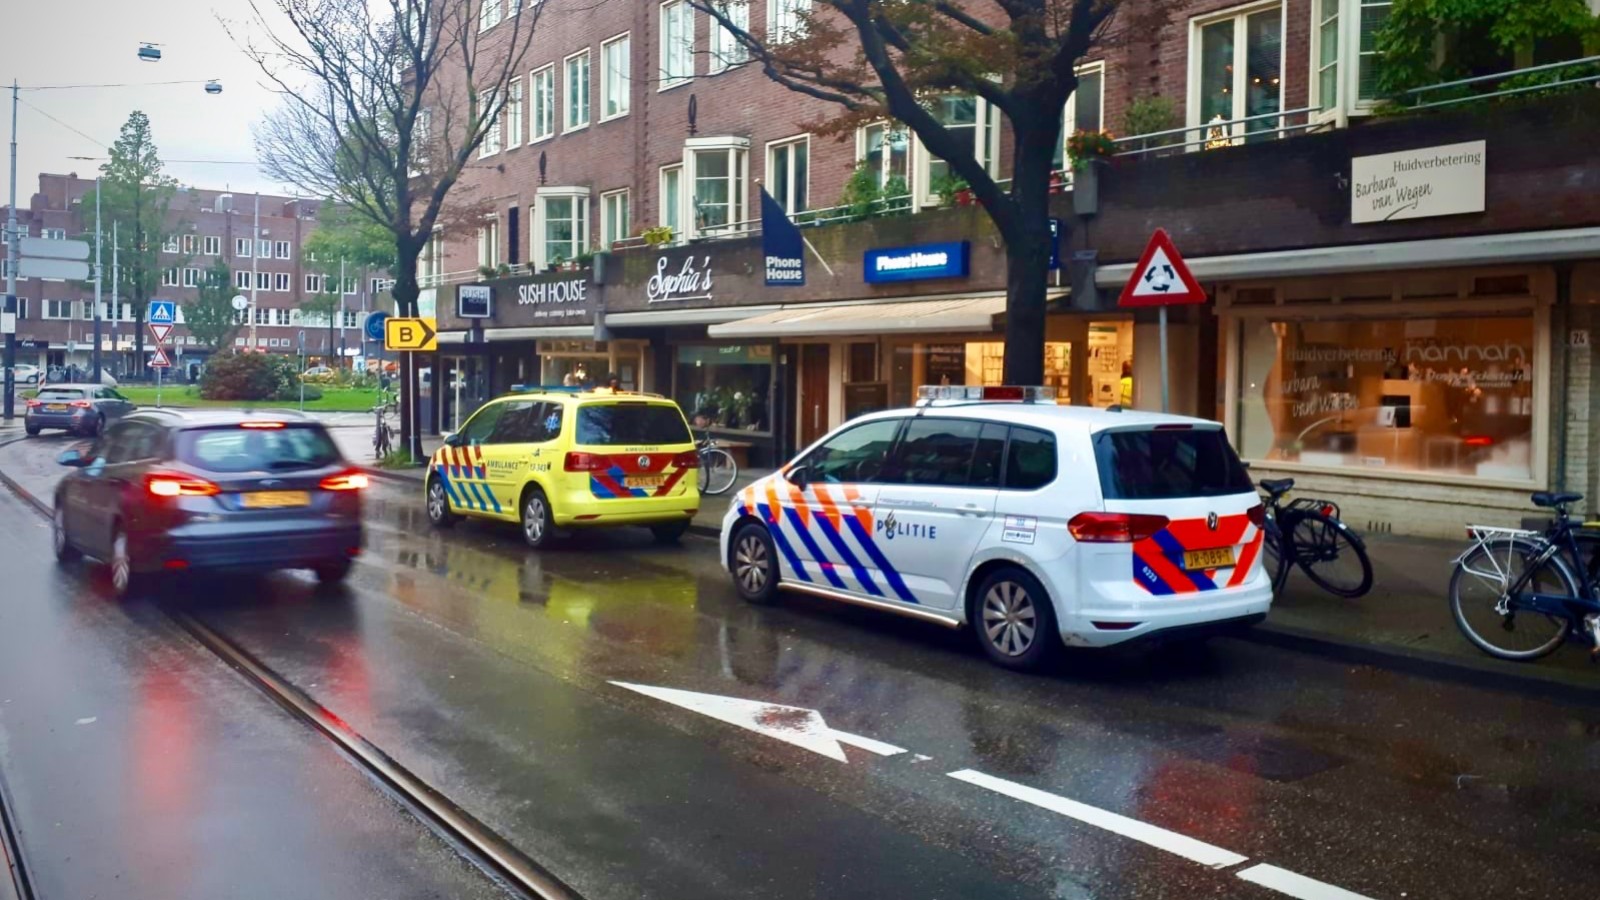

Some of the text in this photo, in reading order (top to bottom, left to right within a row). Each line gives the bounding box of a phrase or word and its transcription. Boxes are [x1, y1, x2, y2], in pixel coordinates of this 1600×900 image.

[1393, 151, 1481, 173] Huidverbetering
[1355, 175, 1398, 198] Barbara
[1372, 183, 1433, 210] van Wegen
[766, 256, 801, 268] Phone
[876, 251, 948, 272] Phone House
[647, 255, 713, 300] Sophia's
[766, 268, 802, 280] House
[462, 288, 488, 299] SUSHI
[518, 279, 587, 305] SUSHI HOUSE
[399, 327, 413, 343] B
[1572, 332, 1586, 345] 24
[1405, 338, 1526, 361] hannah
[487, 459, 519, 471] AMBULANCE
[877, 512, 937, 540] POLITIE
[1187, 548, 1231, 568] JR-089-T
